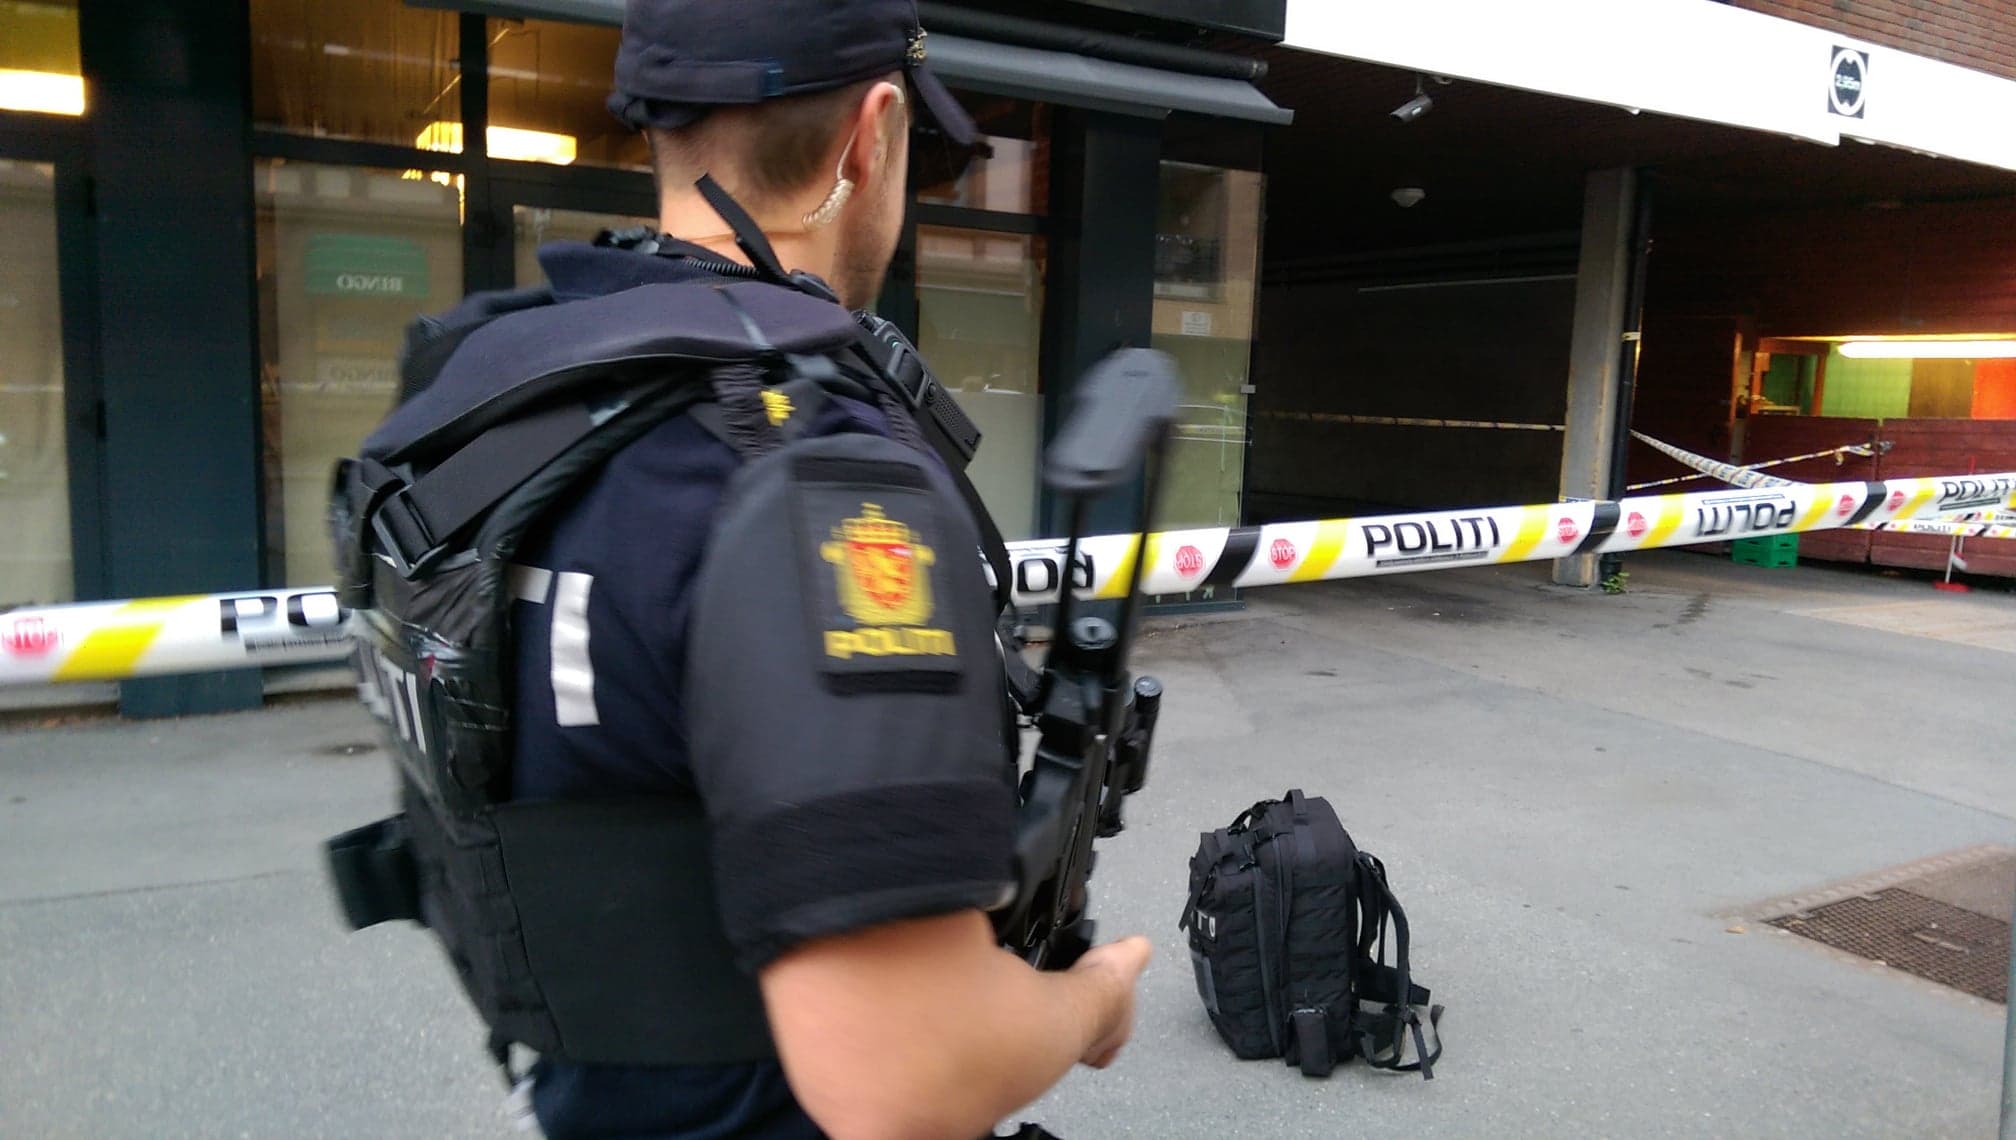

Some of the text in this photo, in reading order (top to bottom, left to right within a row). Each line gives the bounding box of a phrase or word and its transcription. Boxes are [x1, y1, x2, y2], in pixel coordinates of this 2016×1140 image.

[1361, 516, 1499, 558] POLITI
[1696, 501, 1797, 537] POLITI
[1271, 546, 1297, 560] STOP
